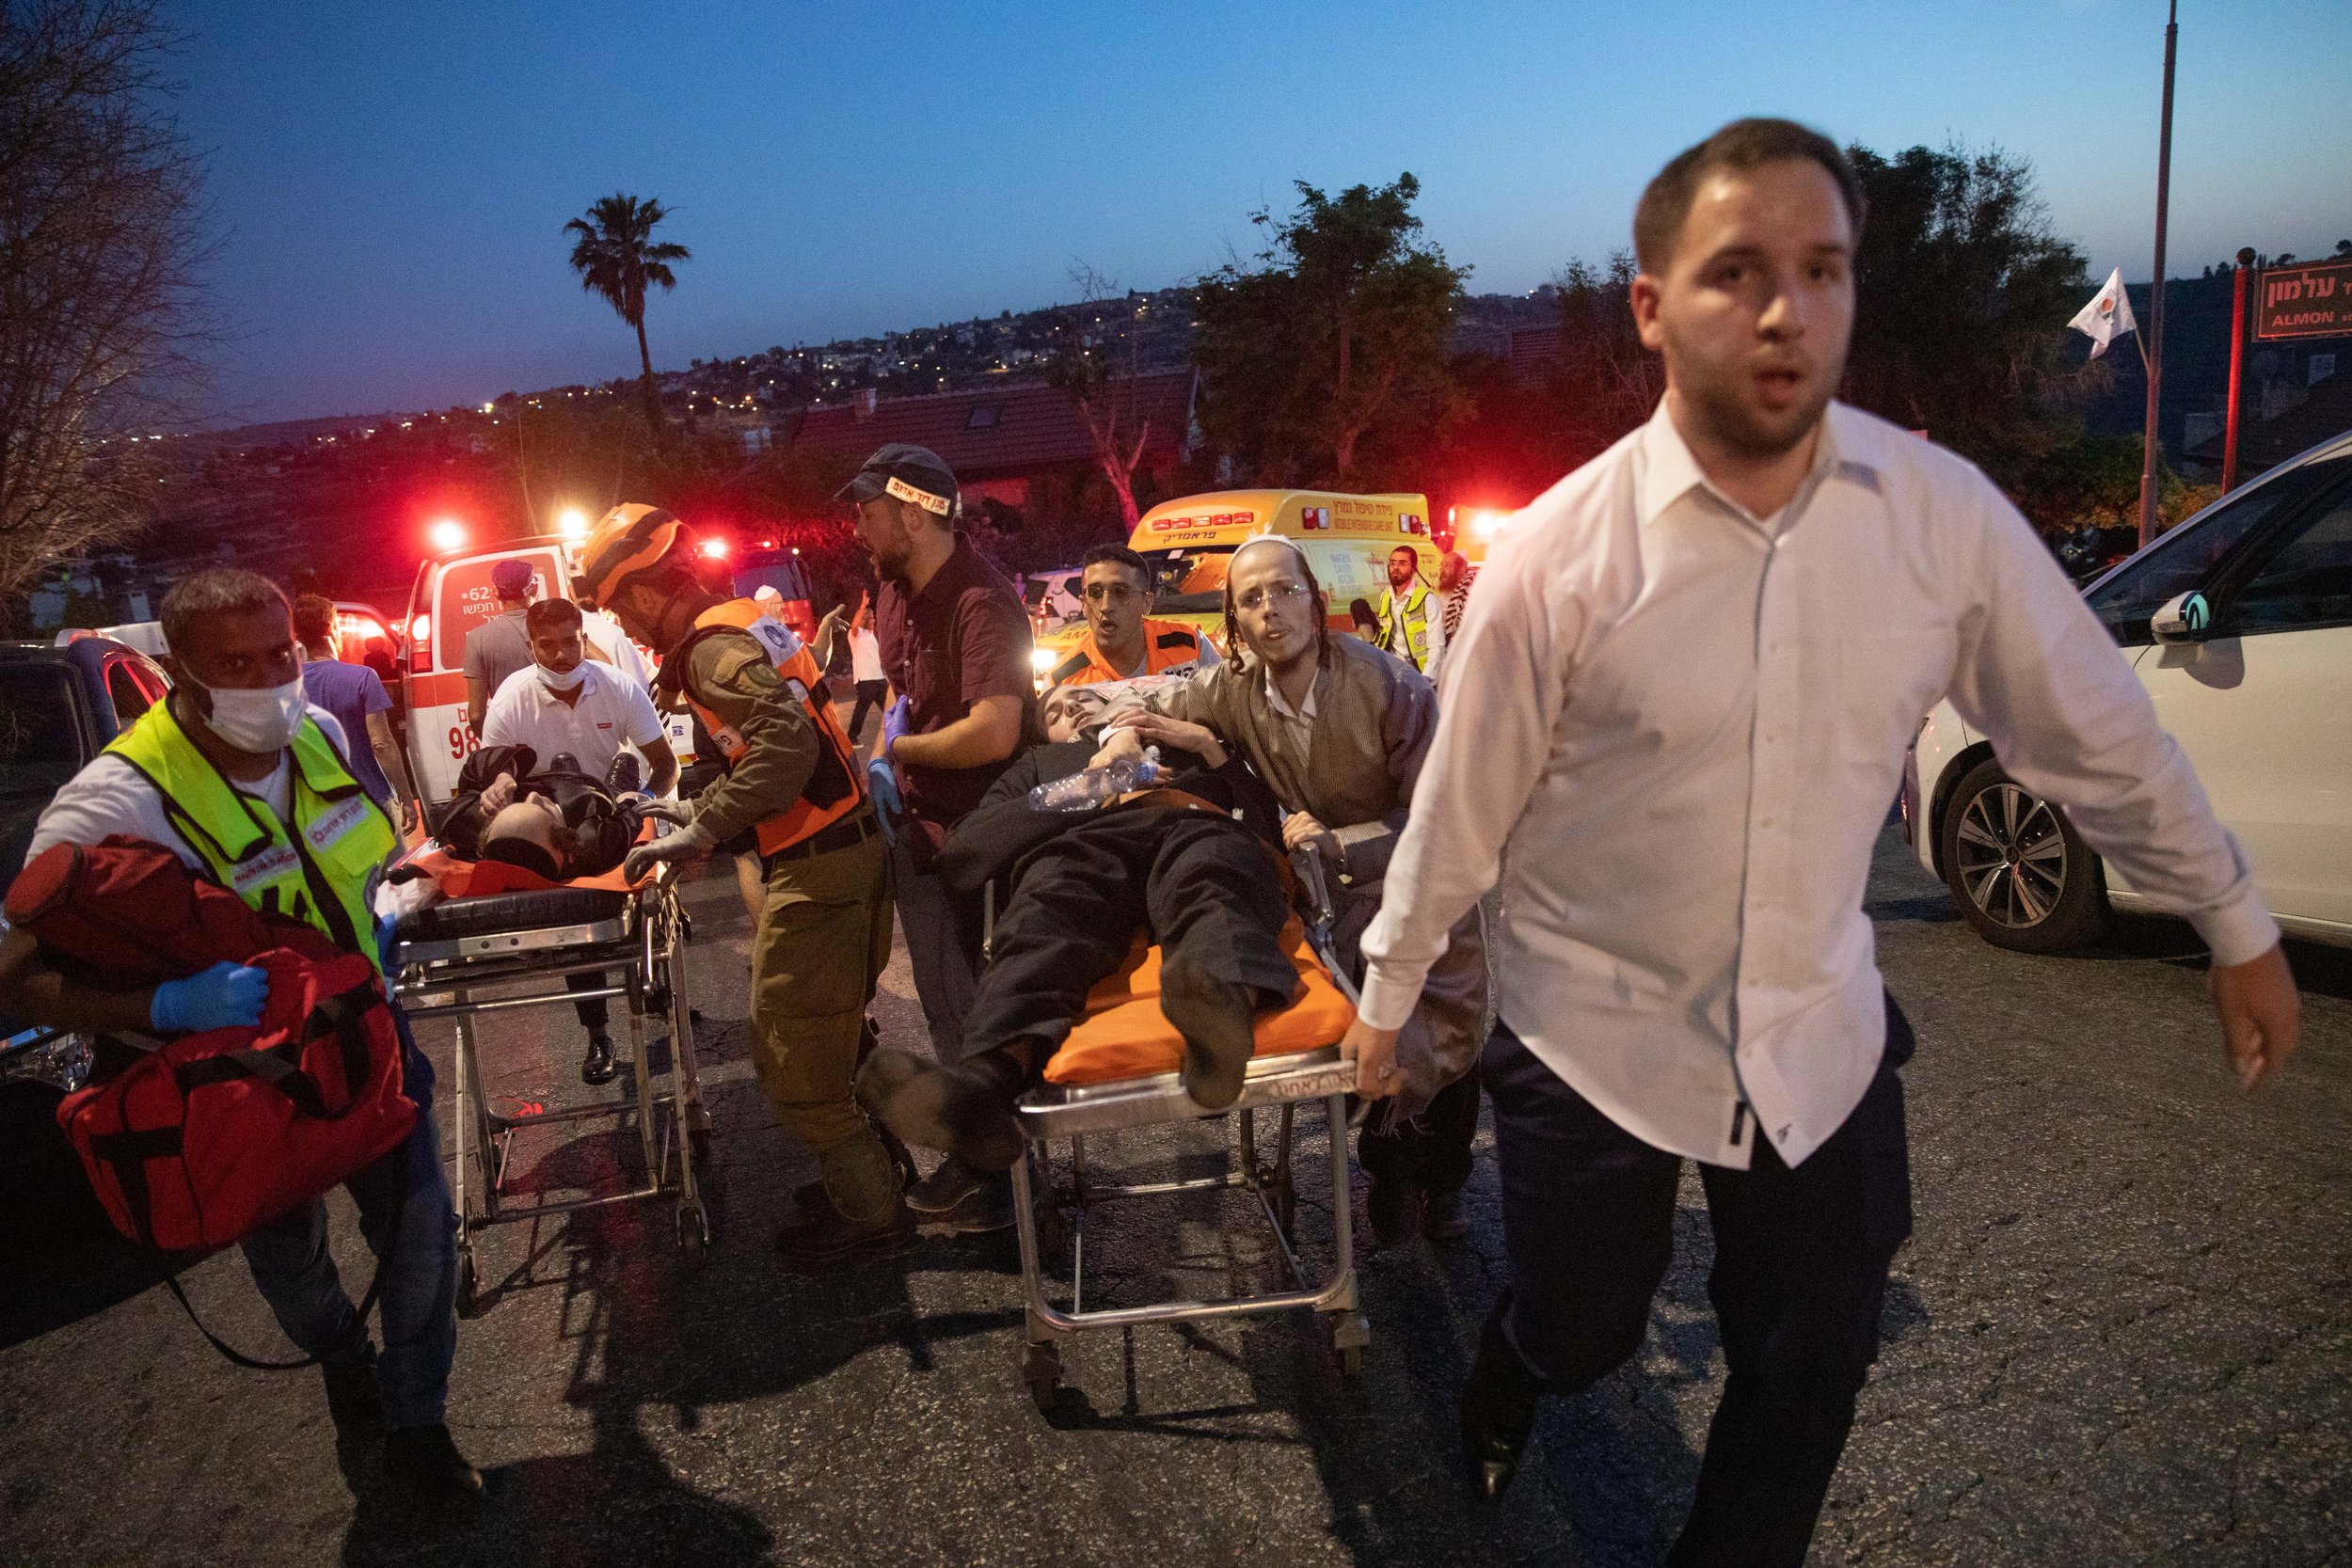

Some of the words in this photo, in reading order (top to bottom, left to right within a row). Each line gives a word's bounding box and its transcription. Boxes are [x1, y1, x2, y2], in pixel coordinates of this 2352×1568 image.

[2268, 273, 2335, 308] עלמון
[2272, 311, 2334, 326] ALMON
[893, 482, 914, 499] אדום
[917, 493, 930, 505] דוד
[1163, 531, 1216, 544] פראמדיק
[463, 602, 495, 615] חפשו
